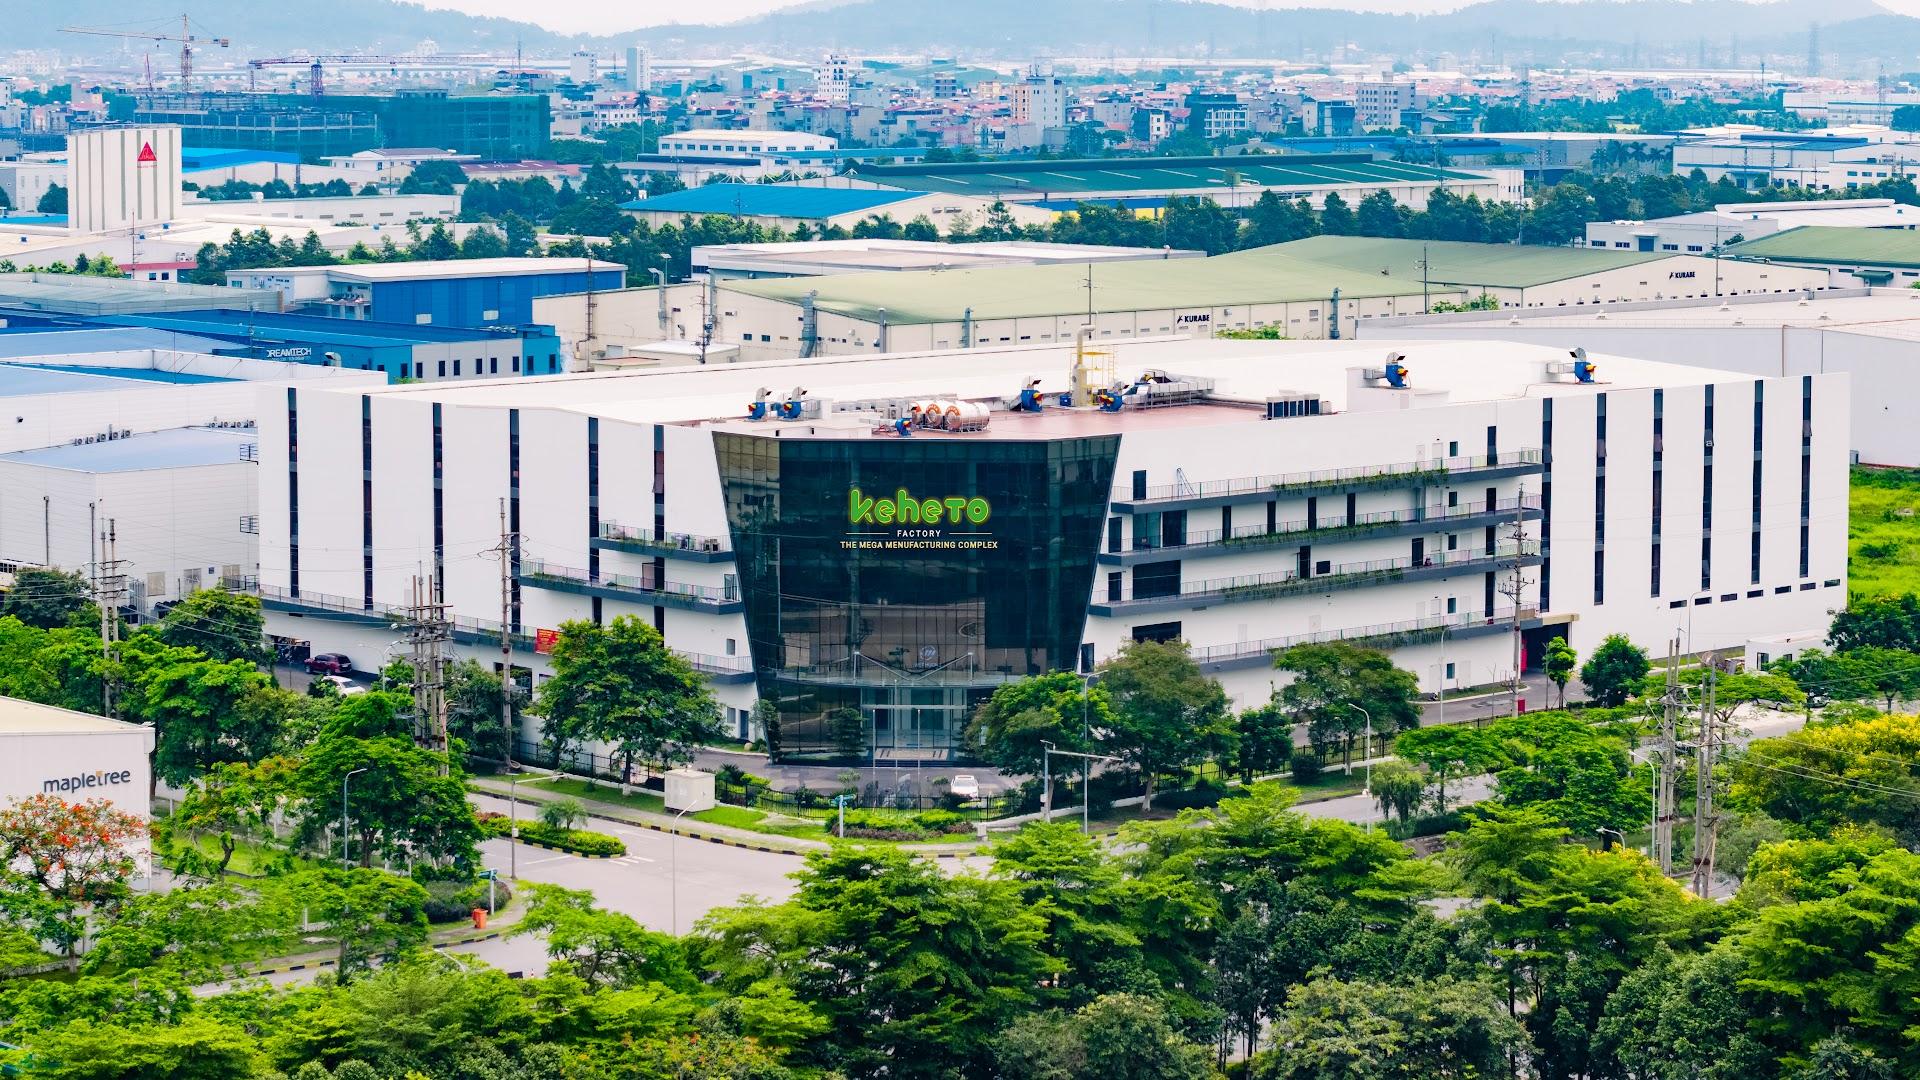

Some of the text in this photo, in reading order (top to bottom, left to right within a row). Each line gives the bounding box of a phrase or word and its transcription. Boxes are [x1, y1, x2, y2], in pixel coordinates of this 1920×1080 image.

[1184, 314, 1210, 322] KURABE
[897, 529, 941, 537] FACTORY
[840, 541, 998, 549] THE MEGA MENUFACTURING COMPLEX
[43, 770, 131, 794] mapletree
